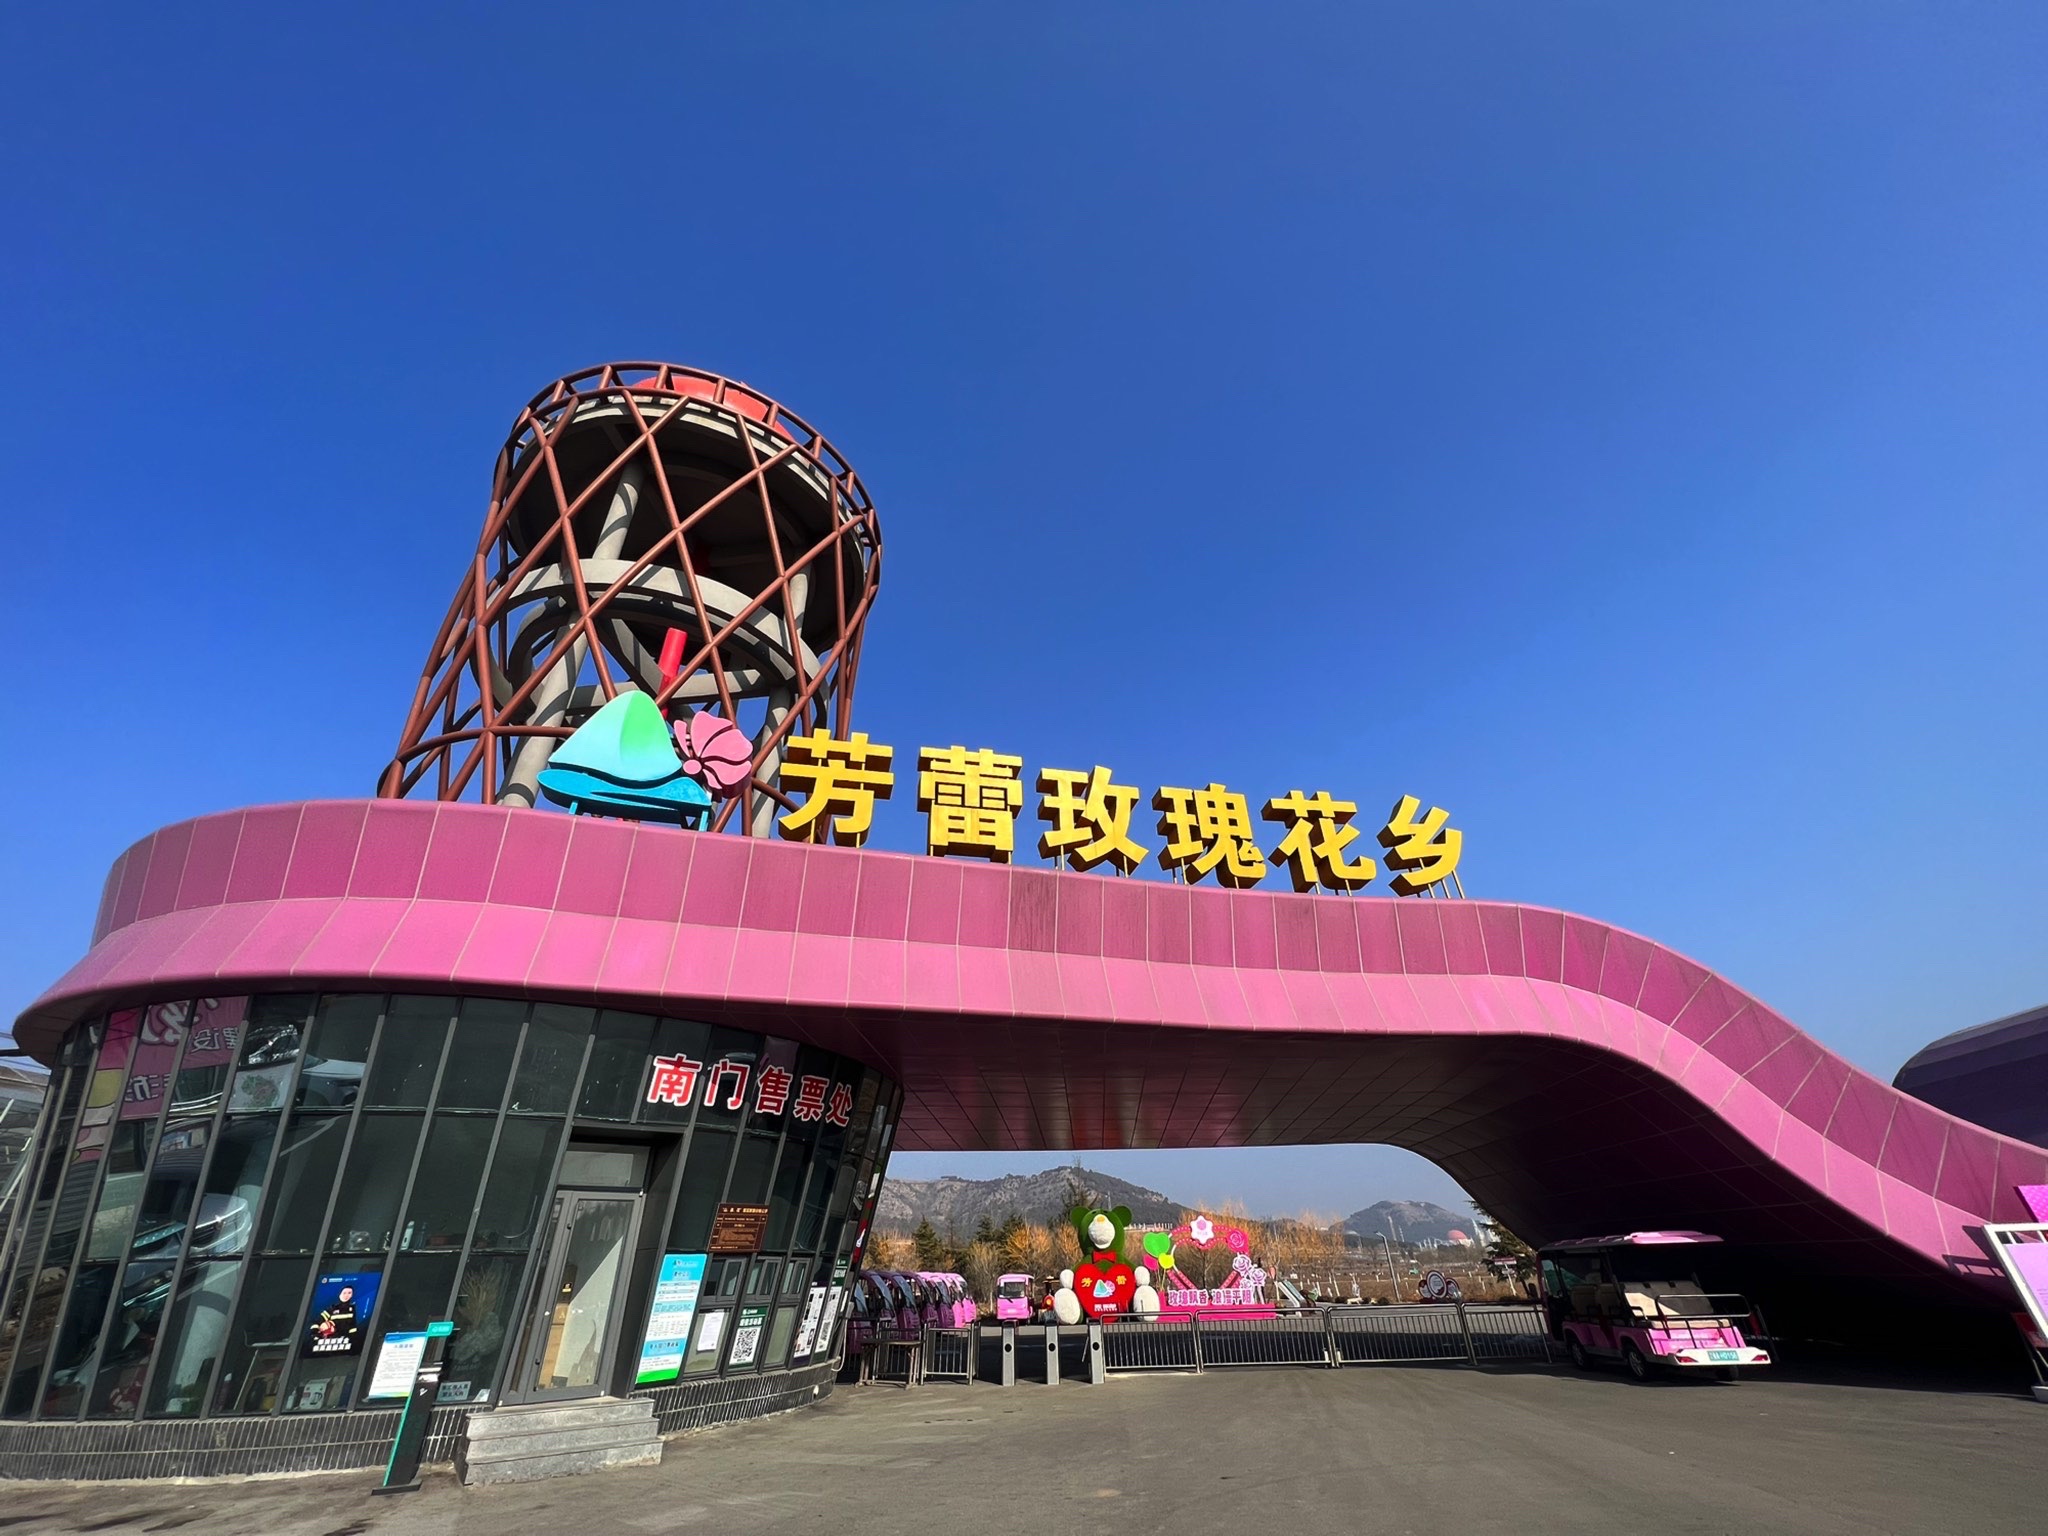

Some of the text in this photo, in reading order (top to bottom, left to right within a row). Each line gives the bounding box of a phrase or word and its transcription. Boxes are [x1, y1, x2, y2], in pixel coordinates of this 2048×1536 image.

[779, 728, 1463, 896] 芳蕾玫瑰花乡
[647, 1053, 853, 1128] 南门售票处
[1168, 1288, 1253, 1306] 玫瑰飘香 浪漫平阴
